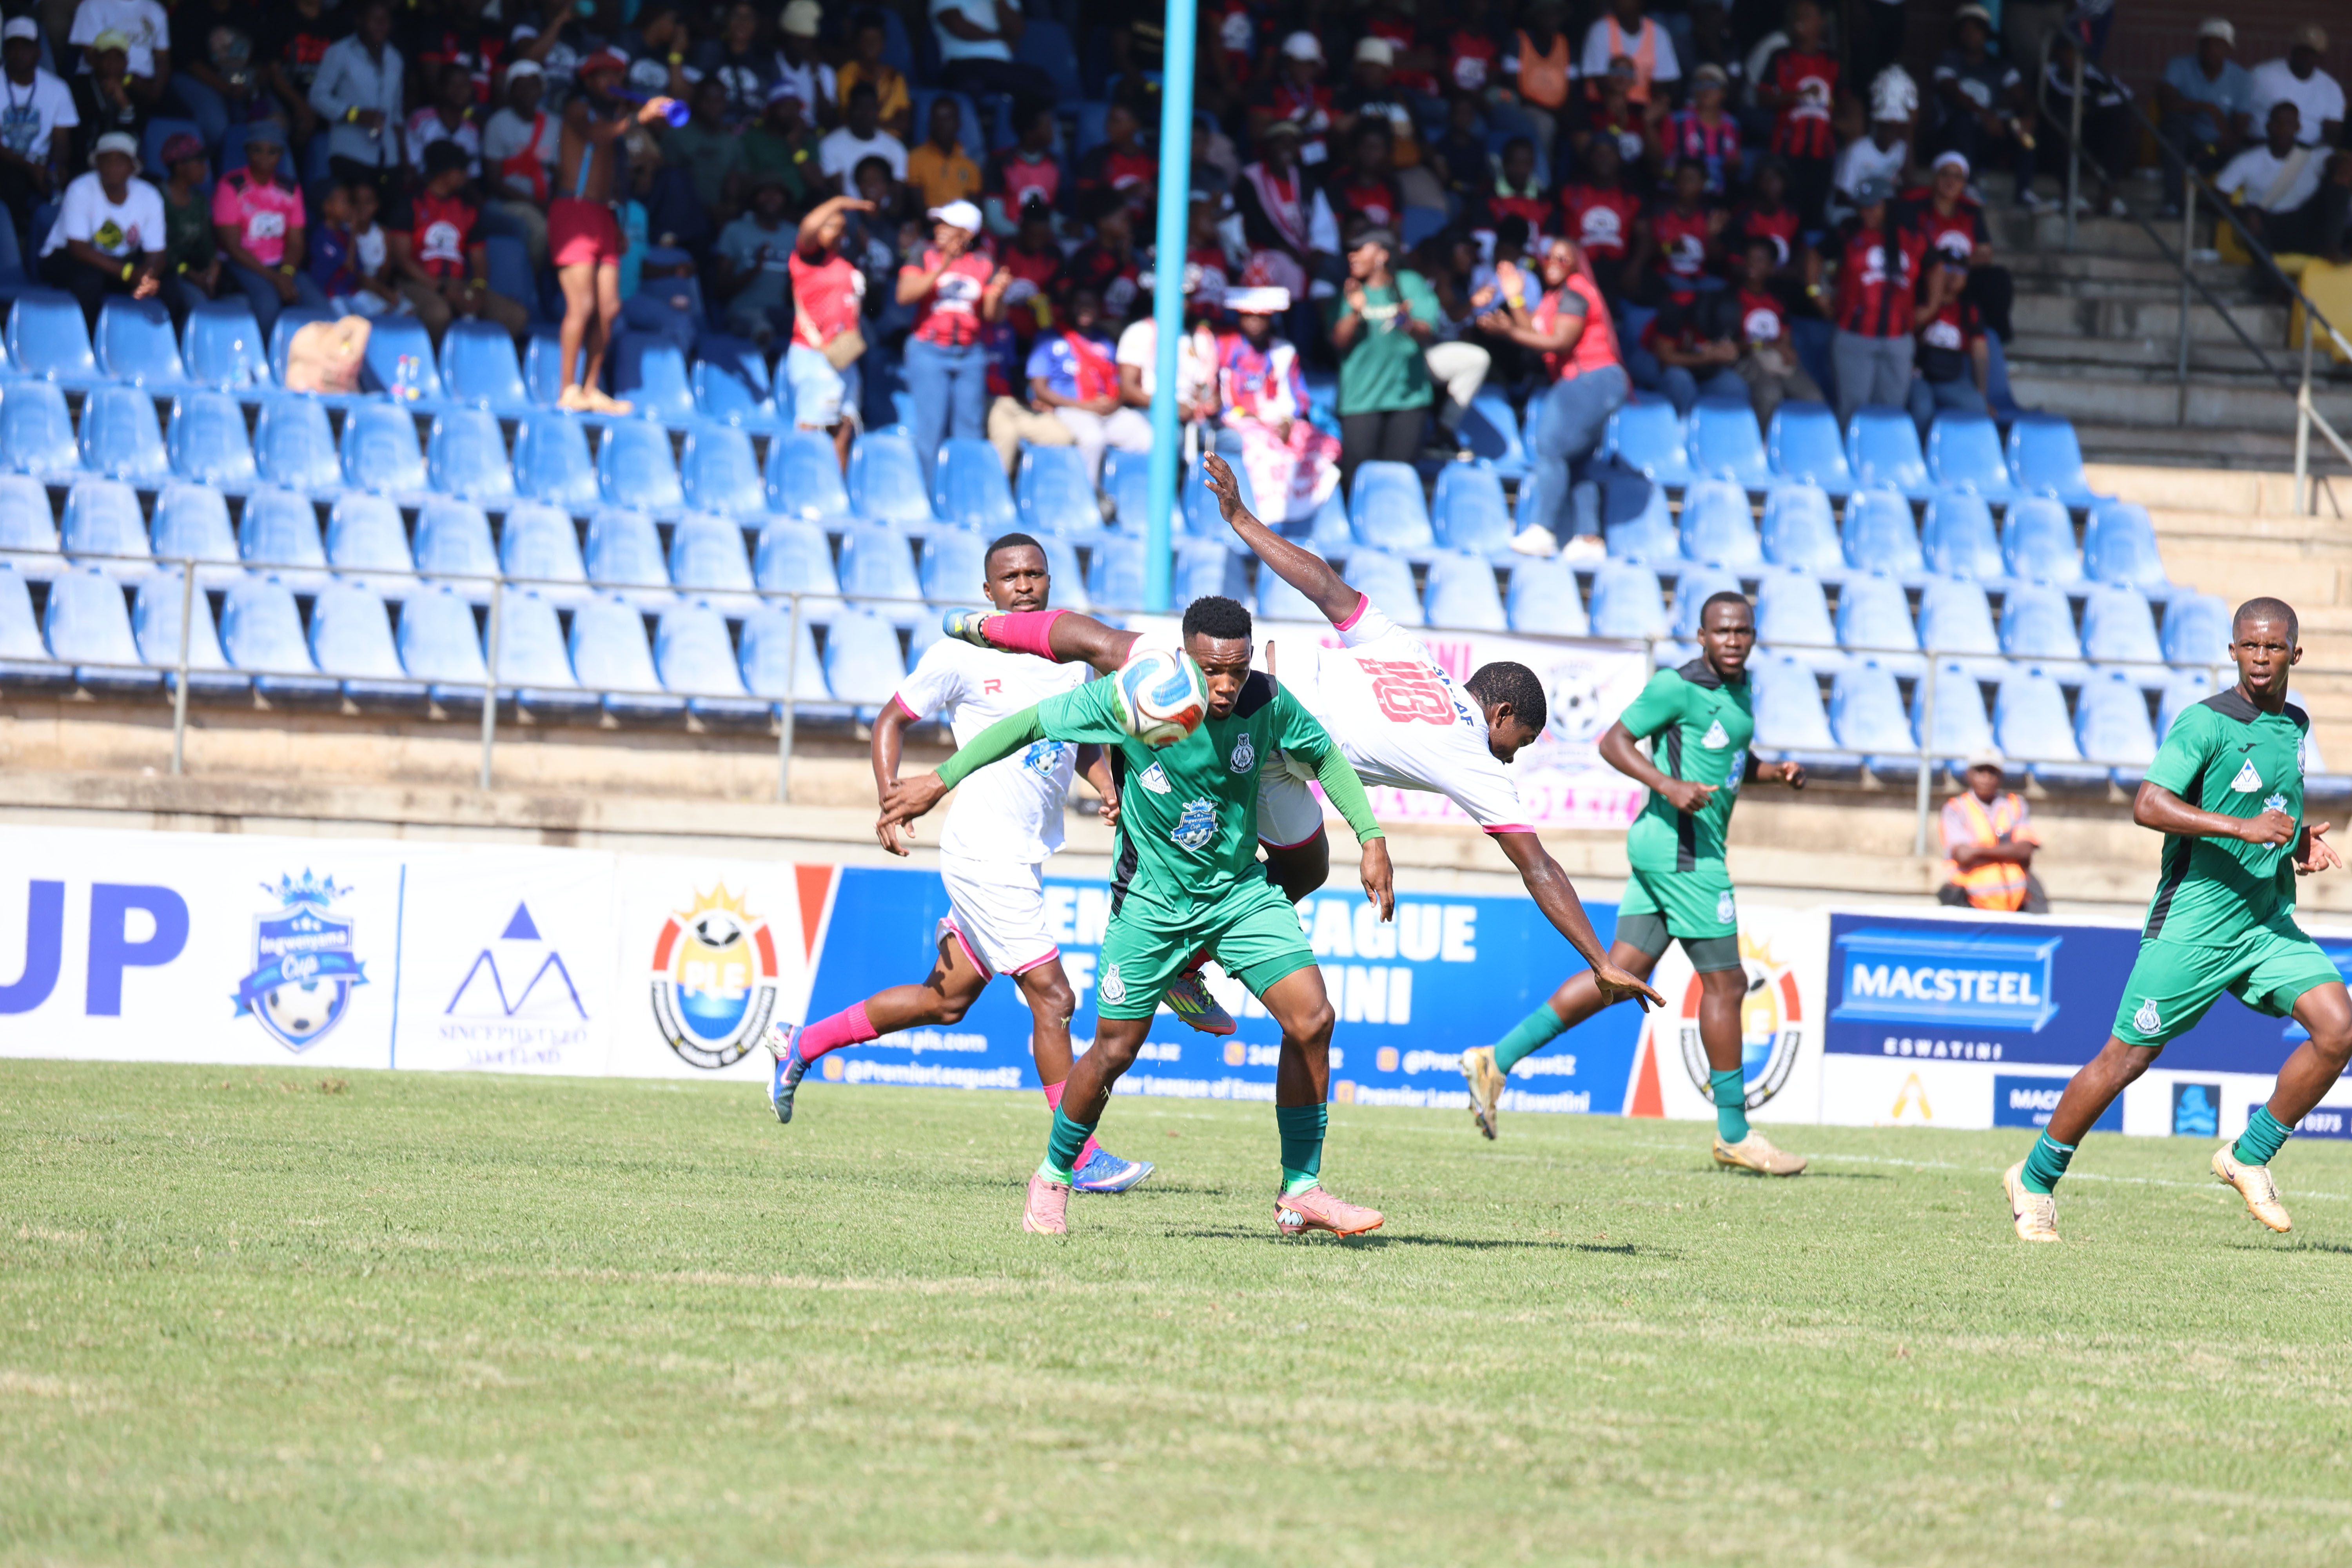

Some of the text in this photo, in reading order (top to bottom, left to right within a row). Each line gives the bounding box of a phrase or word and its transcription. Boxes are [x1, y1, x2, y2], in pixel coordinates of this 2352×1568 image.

[684, 960, 746, 1000] PLE
[1852, 963, 2040, 1006] MACSTEEL
[1883, 1036, 2002, 1061] ESWATINI
